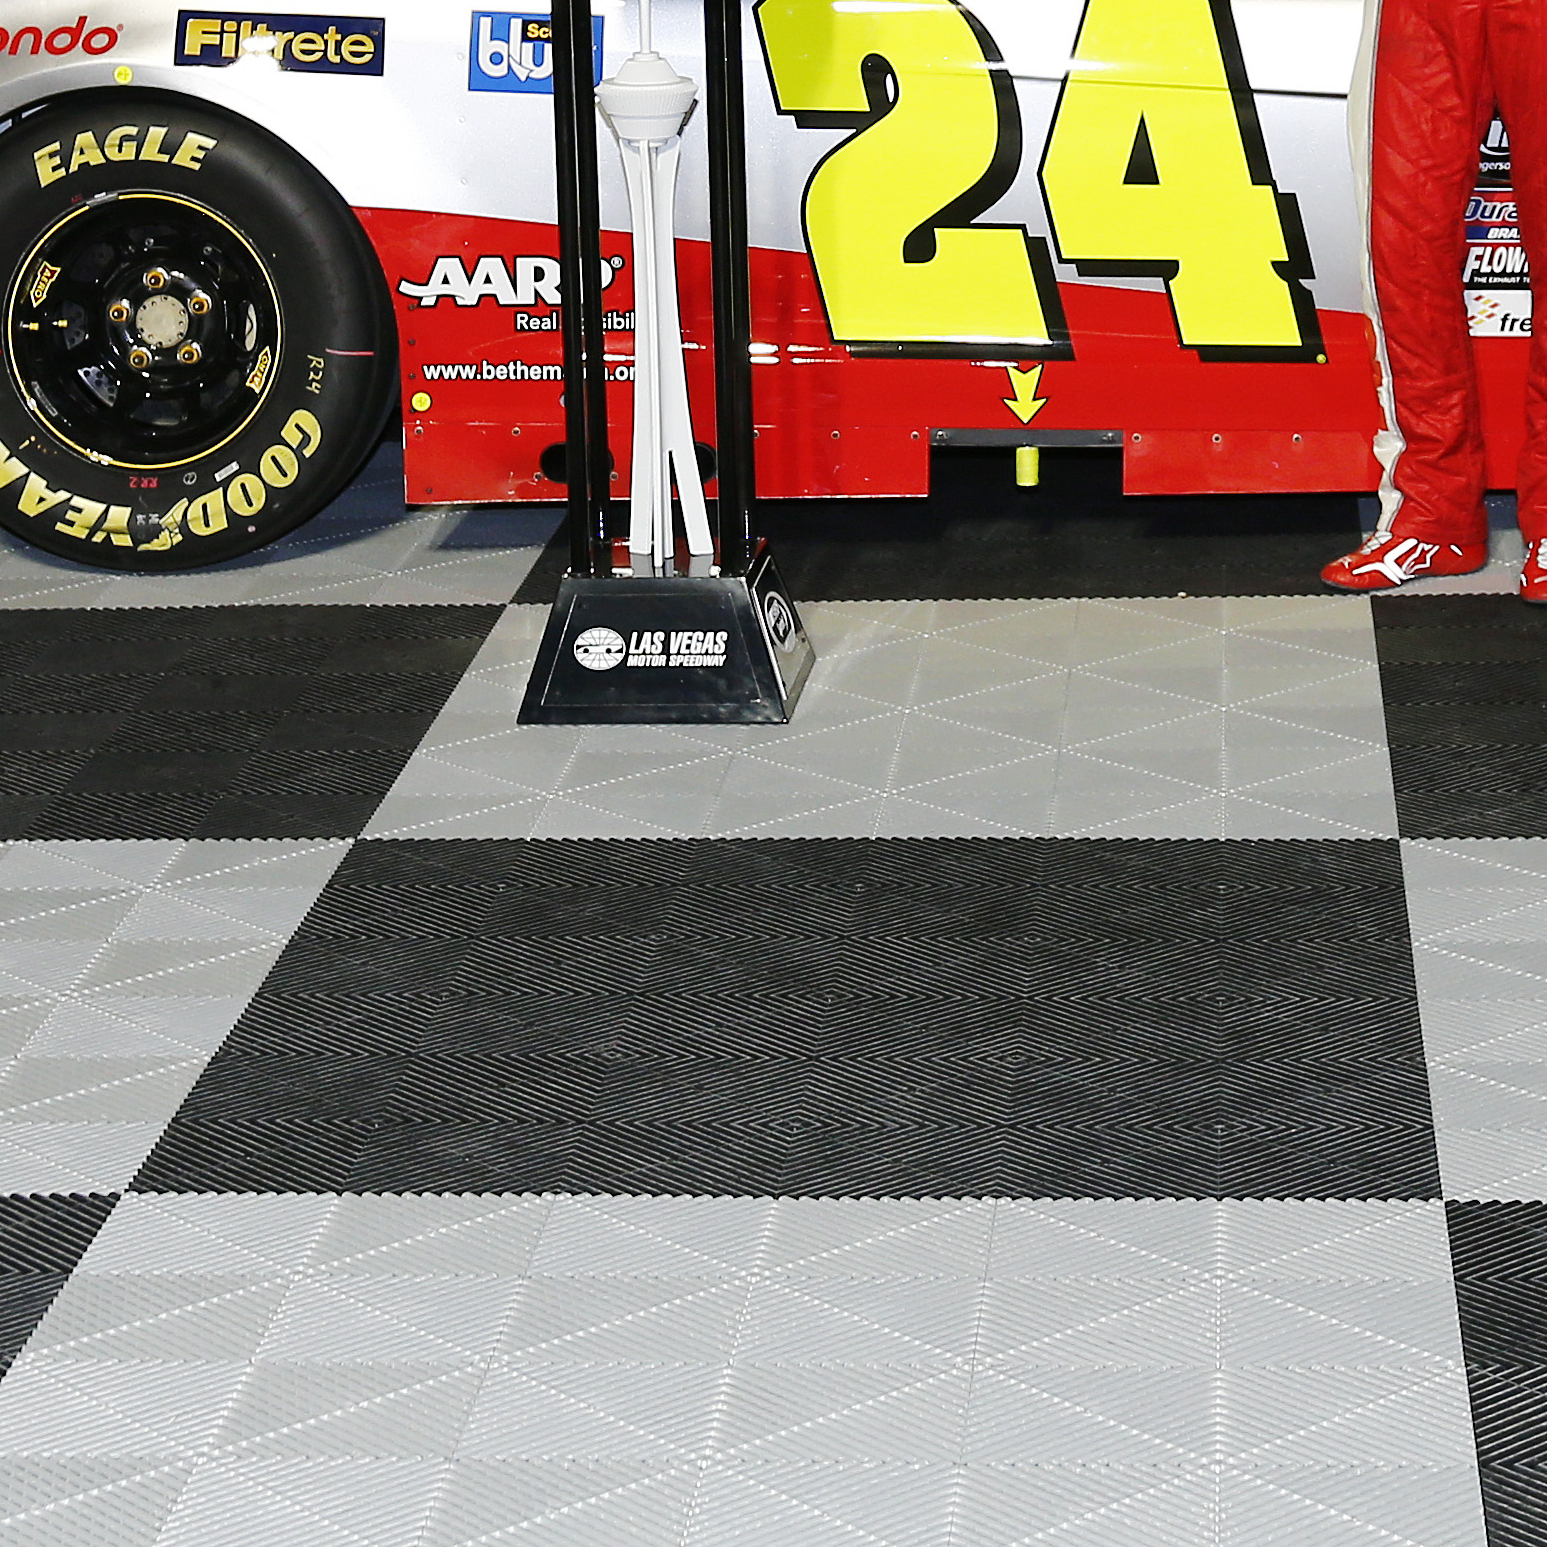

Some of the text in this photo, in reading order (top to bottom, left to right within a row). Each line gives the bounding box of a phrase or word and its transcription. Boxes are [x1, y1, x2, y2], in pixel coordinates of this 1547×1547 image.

[184, 19, 376, 64] Filtrete
[477, 16, 552, 82] blu
[33, 125, 218, 188] EAGLE
[516, 311, 557, 330] Real
[629, 630, 729, 655] LAS VEGAS
[627, 653, 727, 668] MOTOR SPEEDWAY
